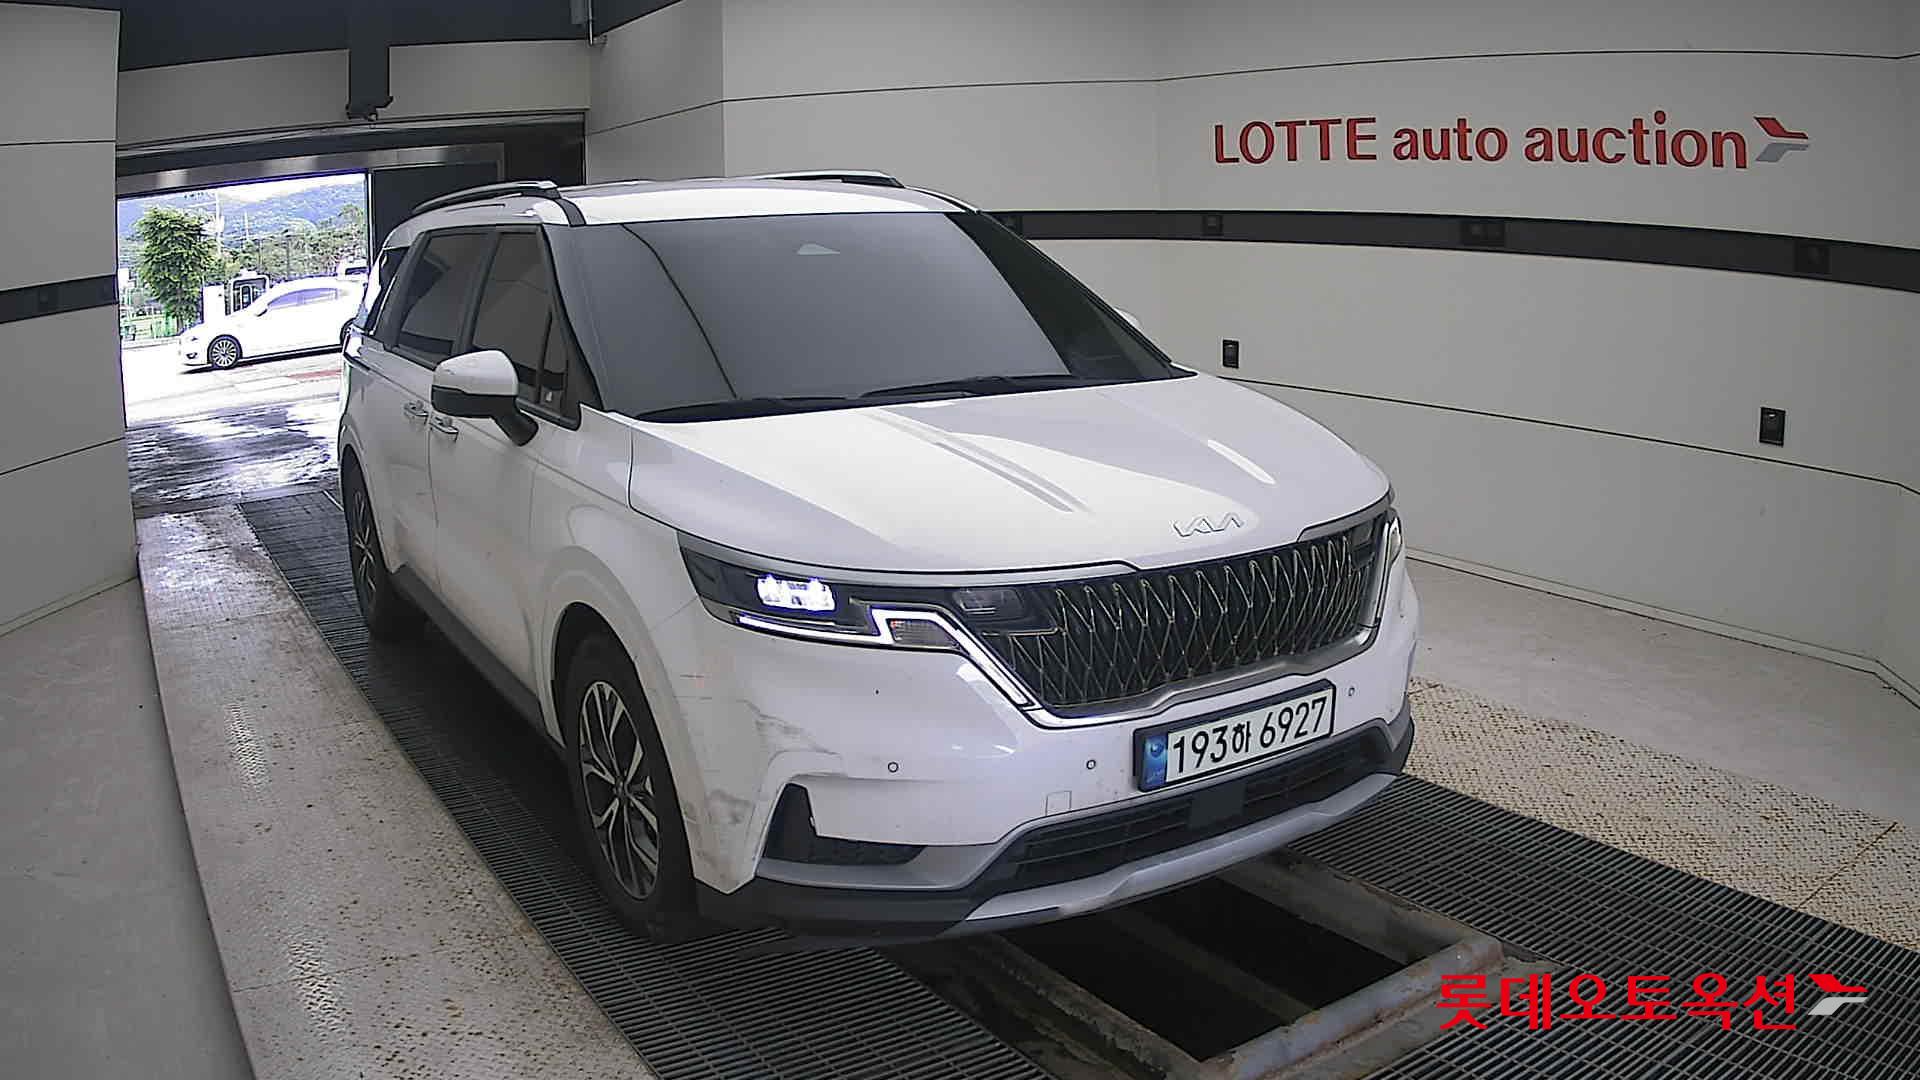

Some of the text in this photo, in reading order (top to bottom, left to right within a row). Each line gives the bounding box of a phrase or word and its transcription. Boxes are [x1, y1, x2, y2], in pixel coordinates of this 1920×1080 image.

[1214, 110, 1748, 169] LOTTE auto auction
[1173, 696, 1328, 774] 193하 6927
